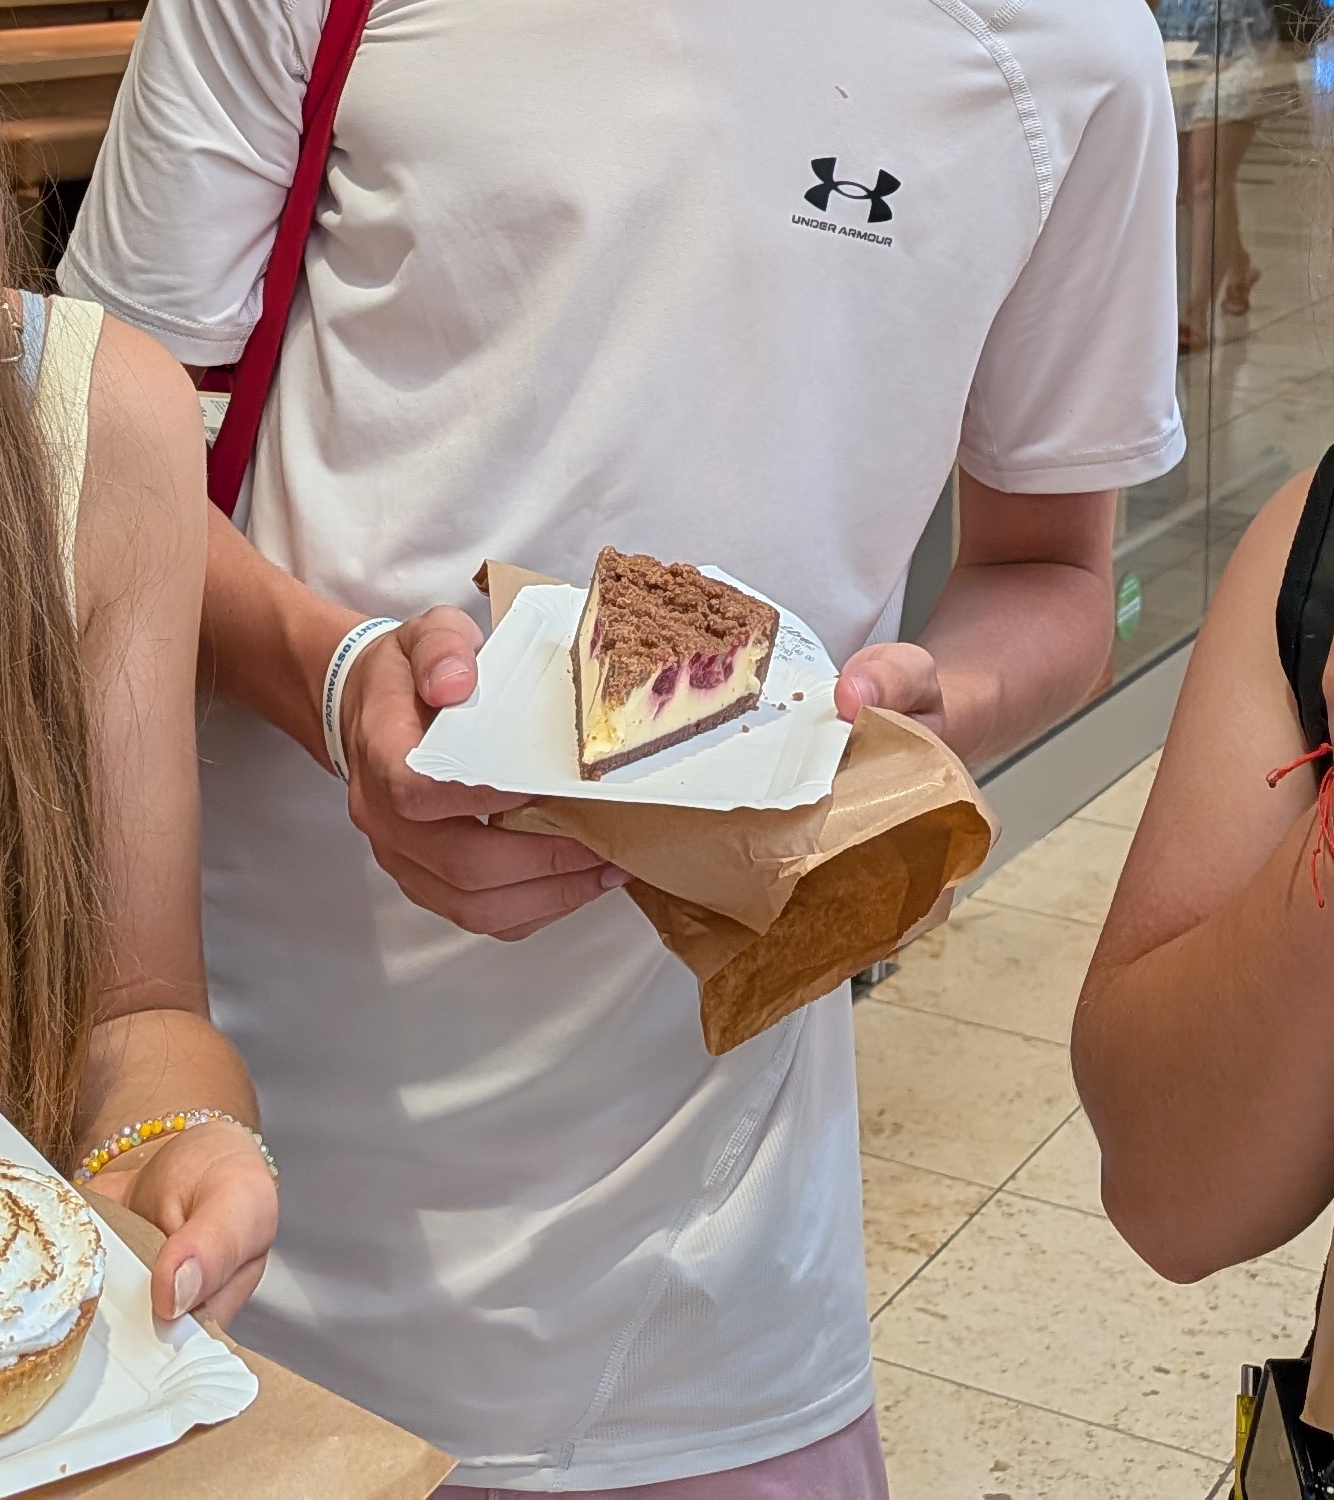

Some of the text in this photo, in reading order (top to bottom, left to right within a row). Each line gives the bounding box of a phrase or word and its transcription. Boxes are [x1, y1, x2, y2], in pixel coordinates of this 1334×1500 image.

[791, 214, 893, 247] UNDER ARMOUR
[326, 644, 352, 705] OSTRAVA
[325, 705, 333, 733] CUP
